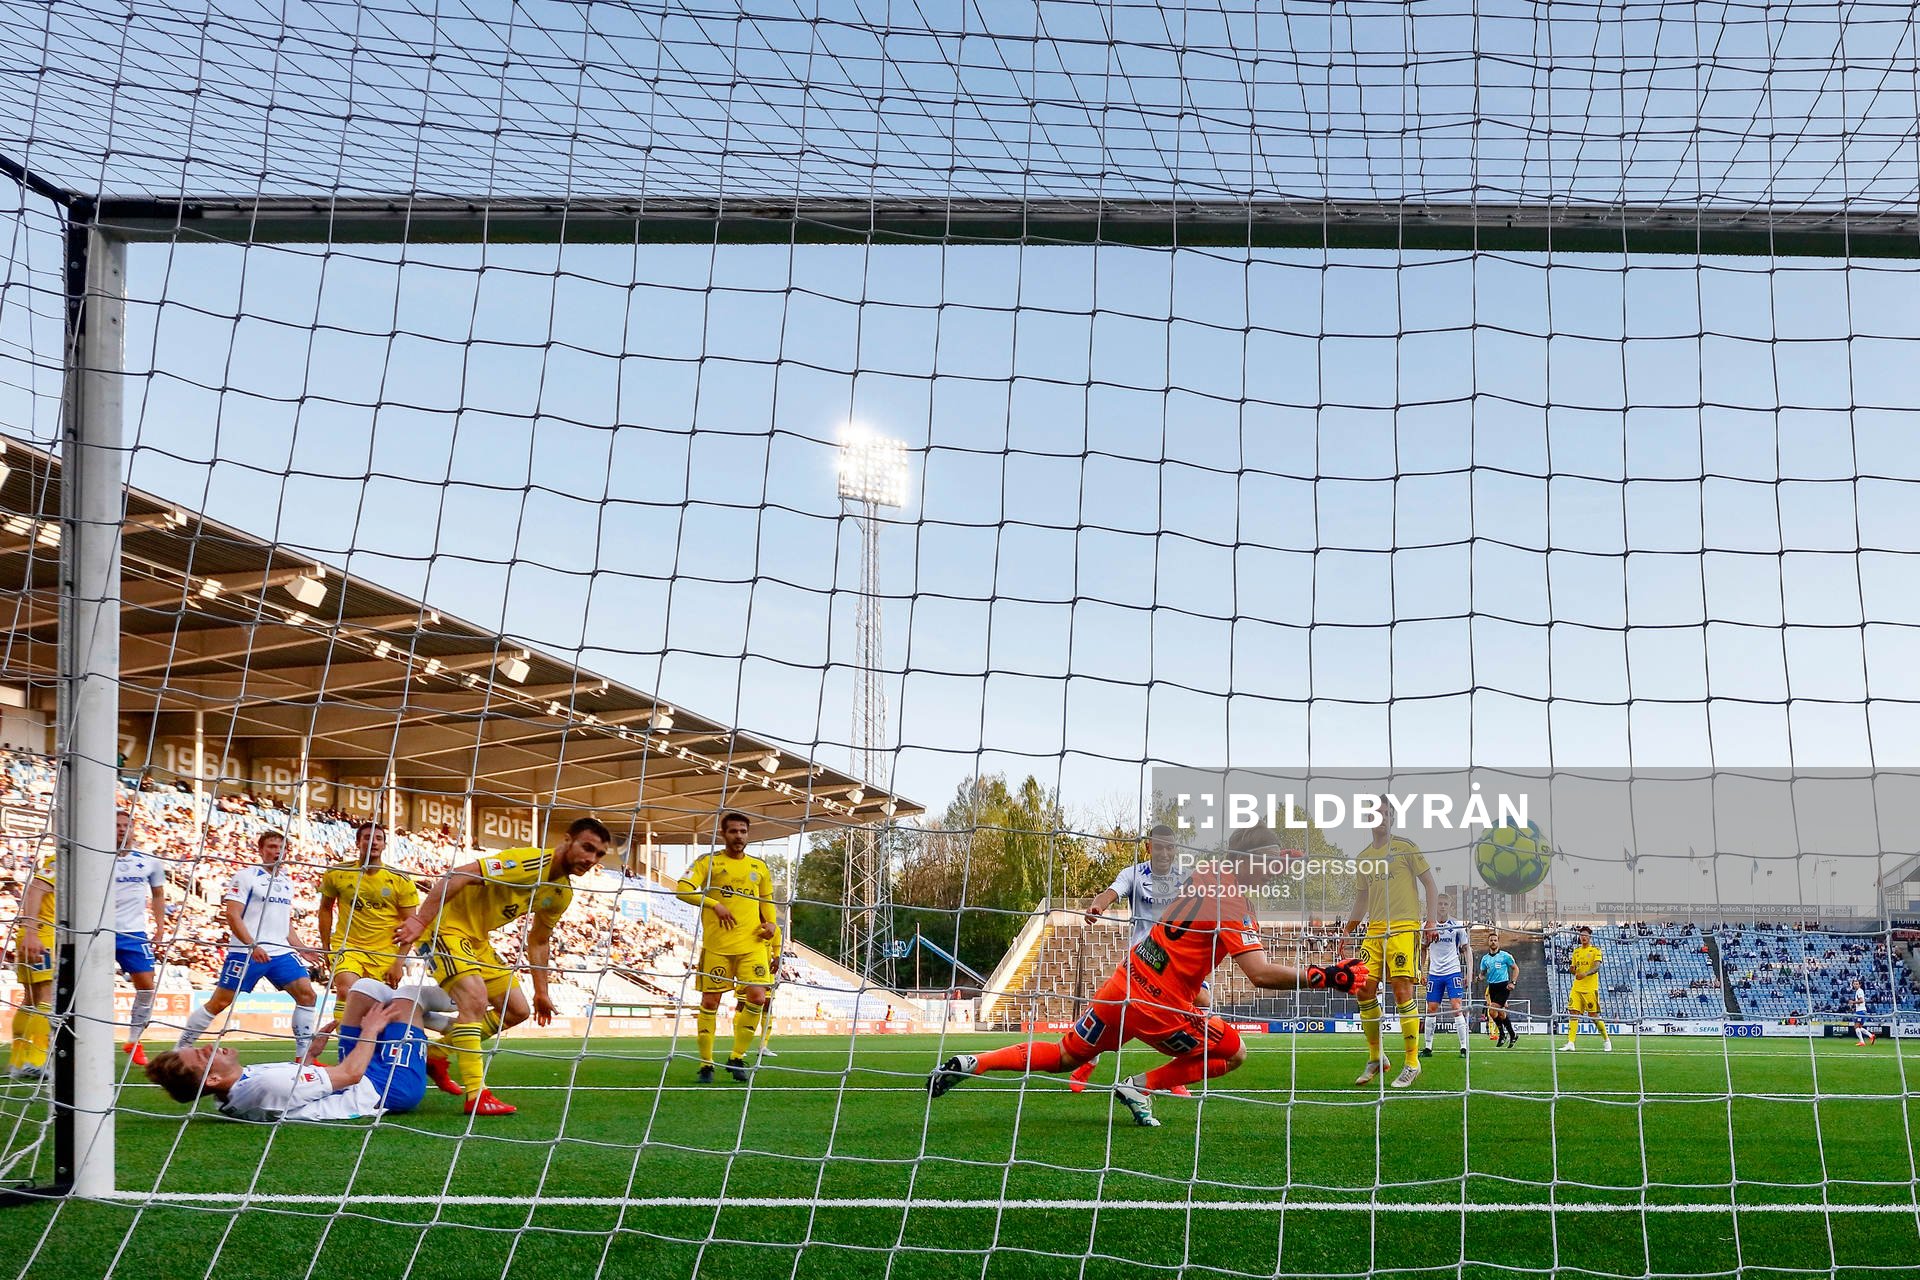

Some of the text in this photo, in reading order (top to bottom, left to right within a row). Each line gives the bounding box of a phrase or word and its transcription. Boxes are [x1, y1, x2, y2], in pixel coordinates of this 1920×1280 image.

[162, 743, 241, 785] 1960
[484, 812, 532, 843] 2015
[736, 887, 755, 898] SCA
[1282, 1021, 1325, 1033] PROJOB
[1561, 1023, 1620, 1034] HLMN
